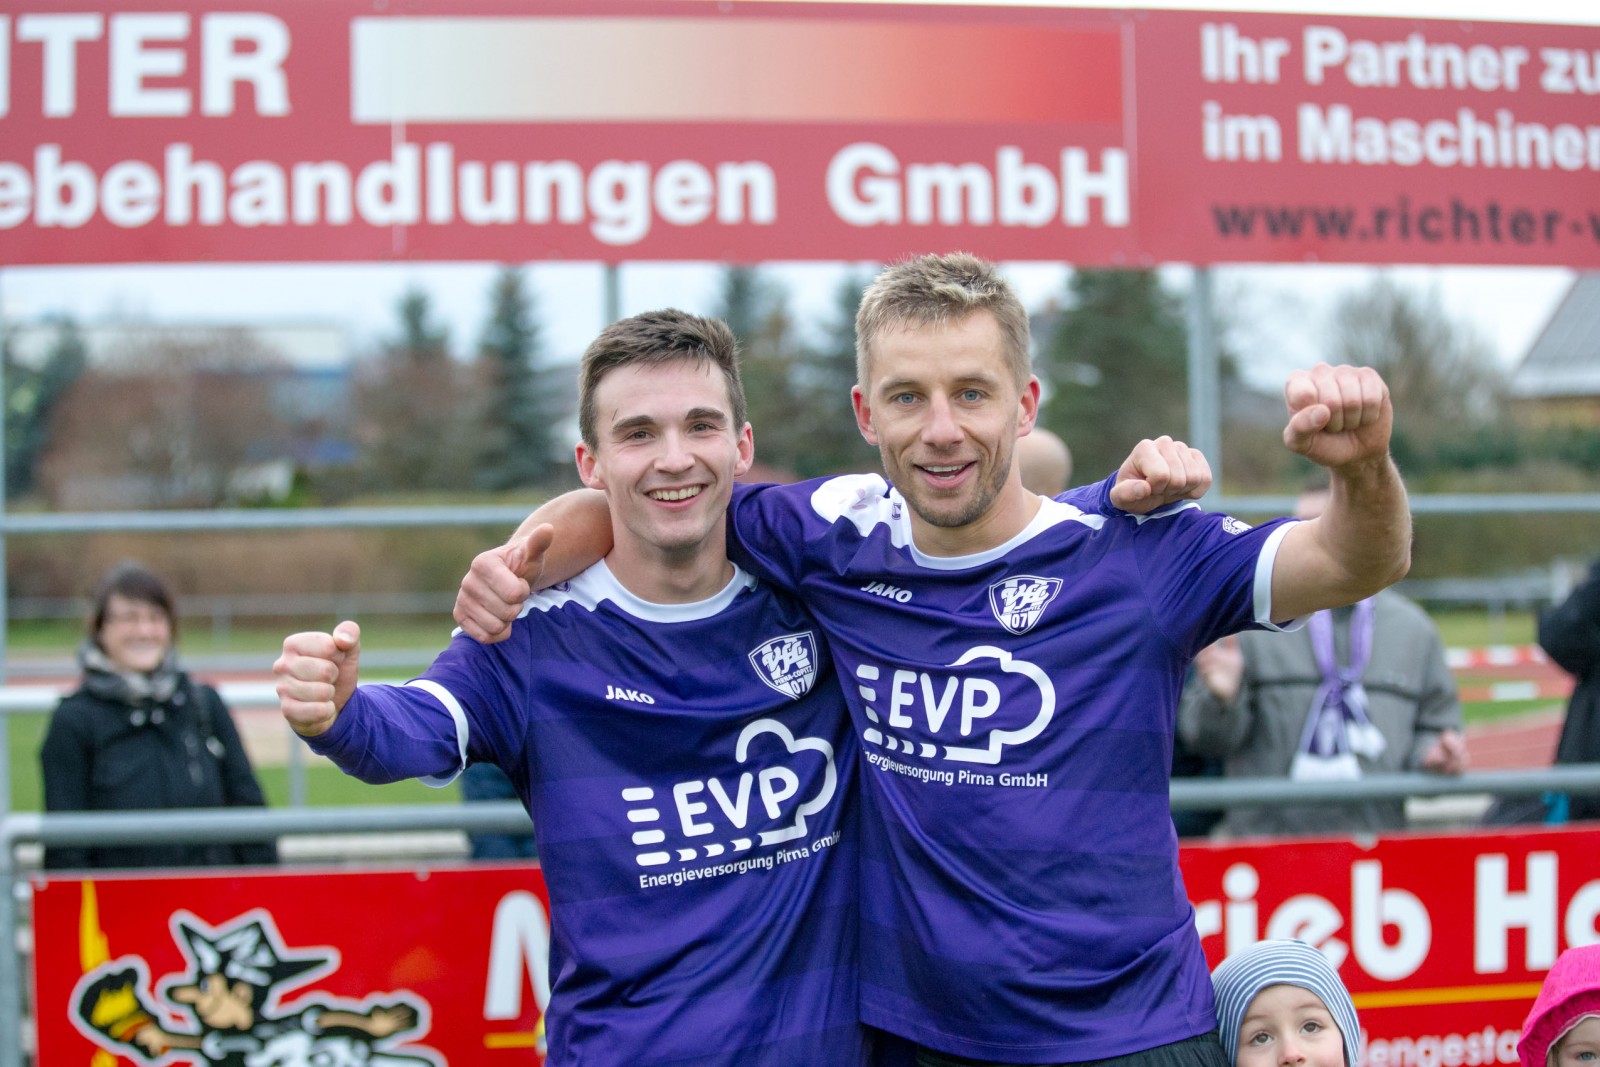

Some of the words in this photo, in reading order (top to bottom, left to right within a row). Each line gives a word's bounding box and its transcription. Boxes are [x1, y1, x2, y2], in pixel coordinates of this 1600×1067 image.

[0, 12, 291, 118] TER
[1201, 23, 1289, 83] Ihr
[1303, 25, 1528, 91] Partner
[1202, 100, 1282, 161] im
[826, 143, 1129, 226] GmbH
[861, 580, 912, 603] JAKO
[1011, 612, 1028, 628] 07
[605, 685, 655, 704] JAKO
[790, 677, 807, 694] 07
[889, 669, 1000, 736] EVP
[863, 748, 954, 786] nergieversorgung
[958, 770, 994, 786] Pirna
[999, 772, 1048, 788] GmbH
[673, 766, 799, 837] EVP
[639, 856, 773, 888] Energieversorgung
[776, 847, 810, 865] Pirna
